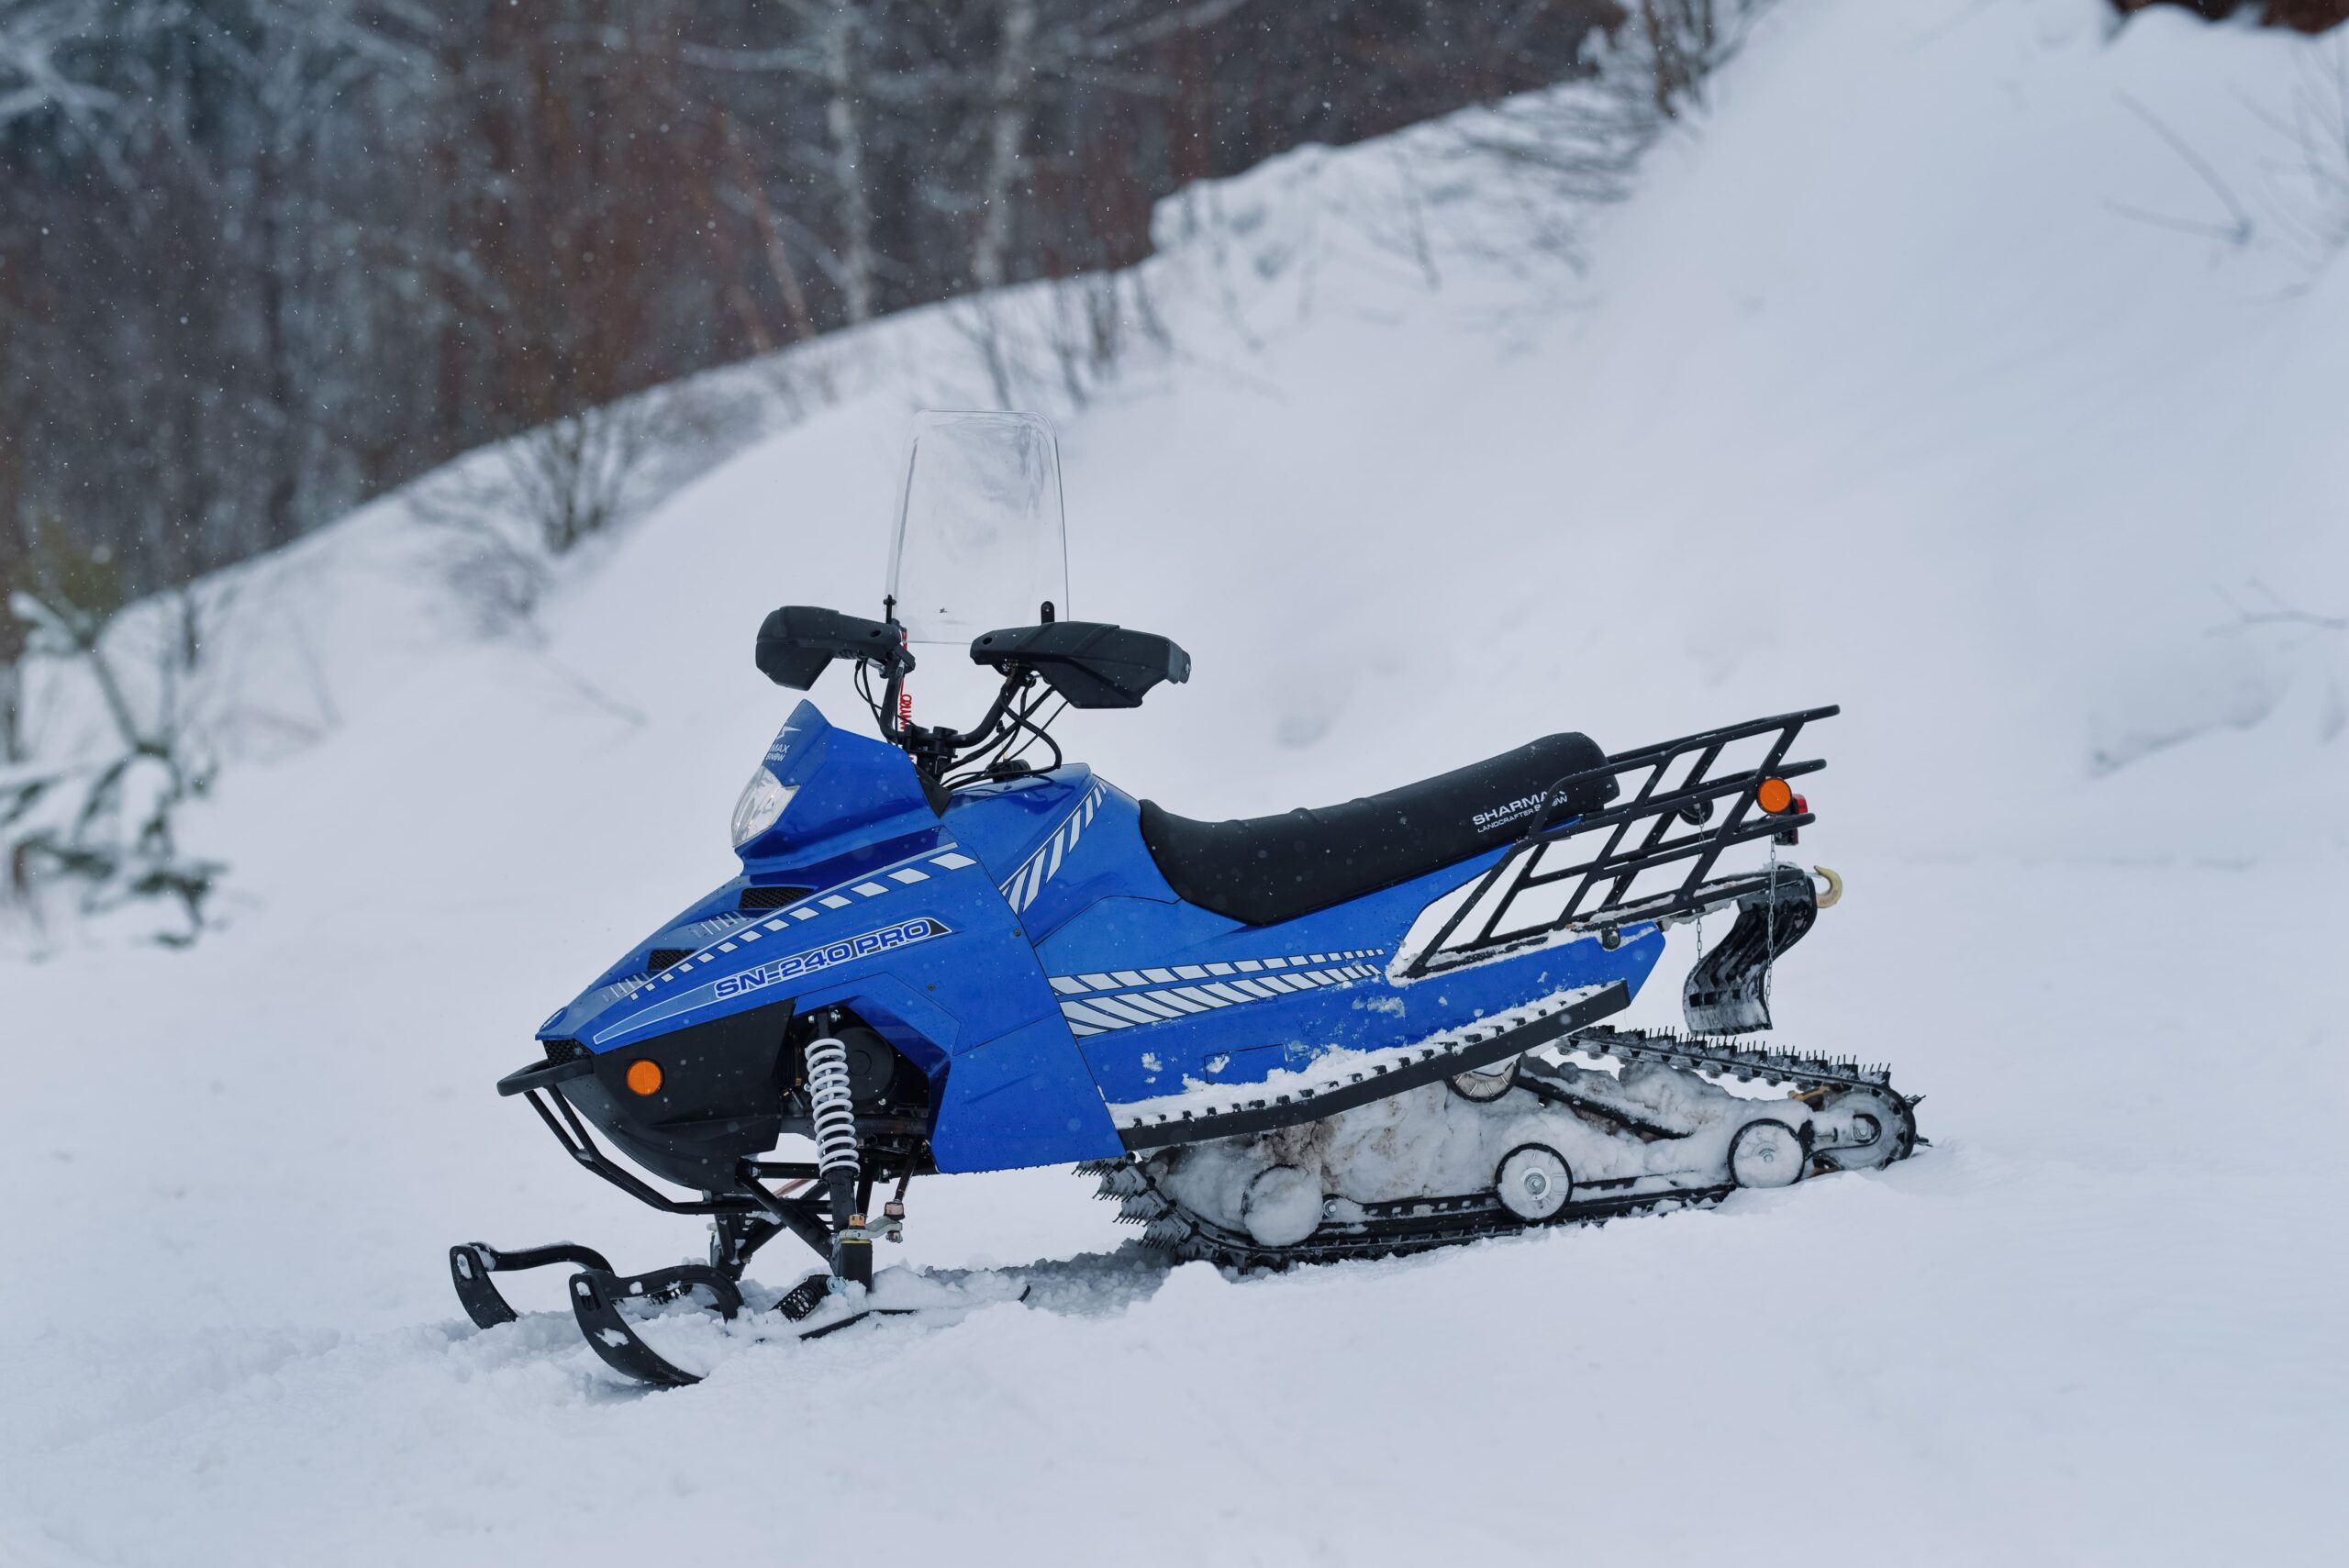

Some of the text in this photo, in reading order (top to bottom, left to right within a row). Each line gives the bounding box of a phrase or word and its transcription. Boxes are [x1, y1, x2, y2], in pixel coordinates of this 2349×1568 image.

[1472, 791, 1566, 826] SHARMA
[1477, 808, 1534, 833] LANDCRAFTER
[715, 919, 930, 999] SN-240 PRO
